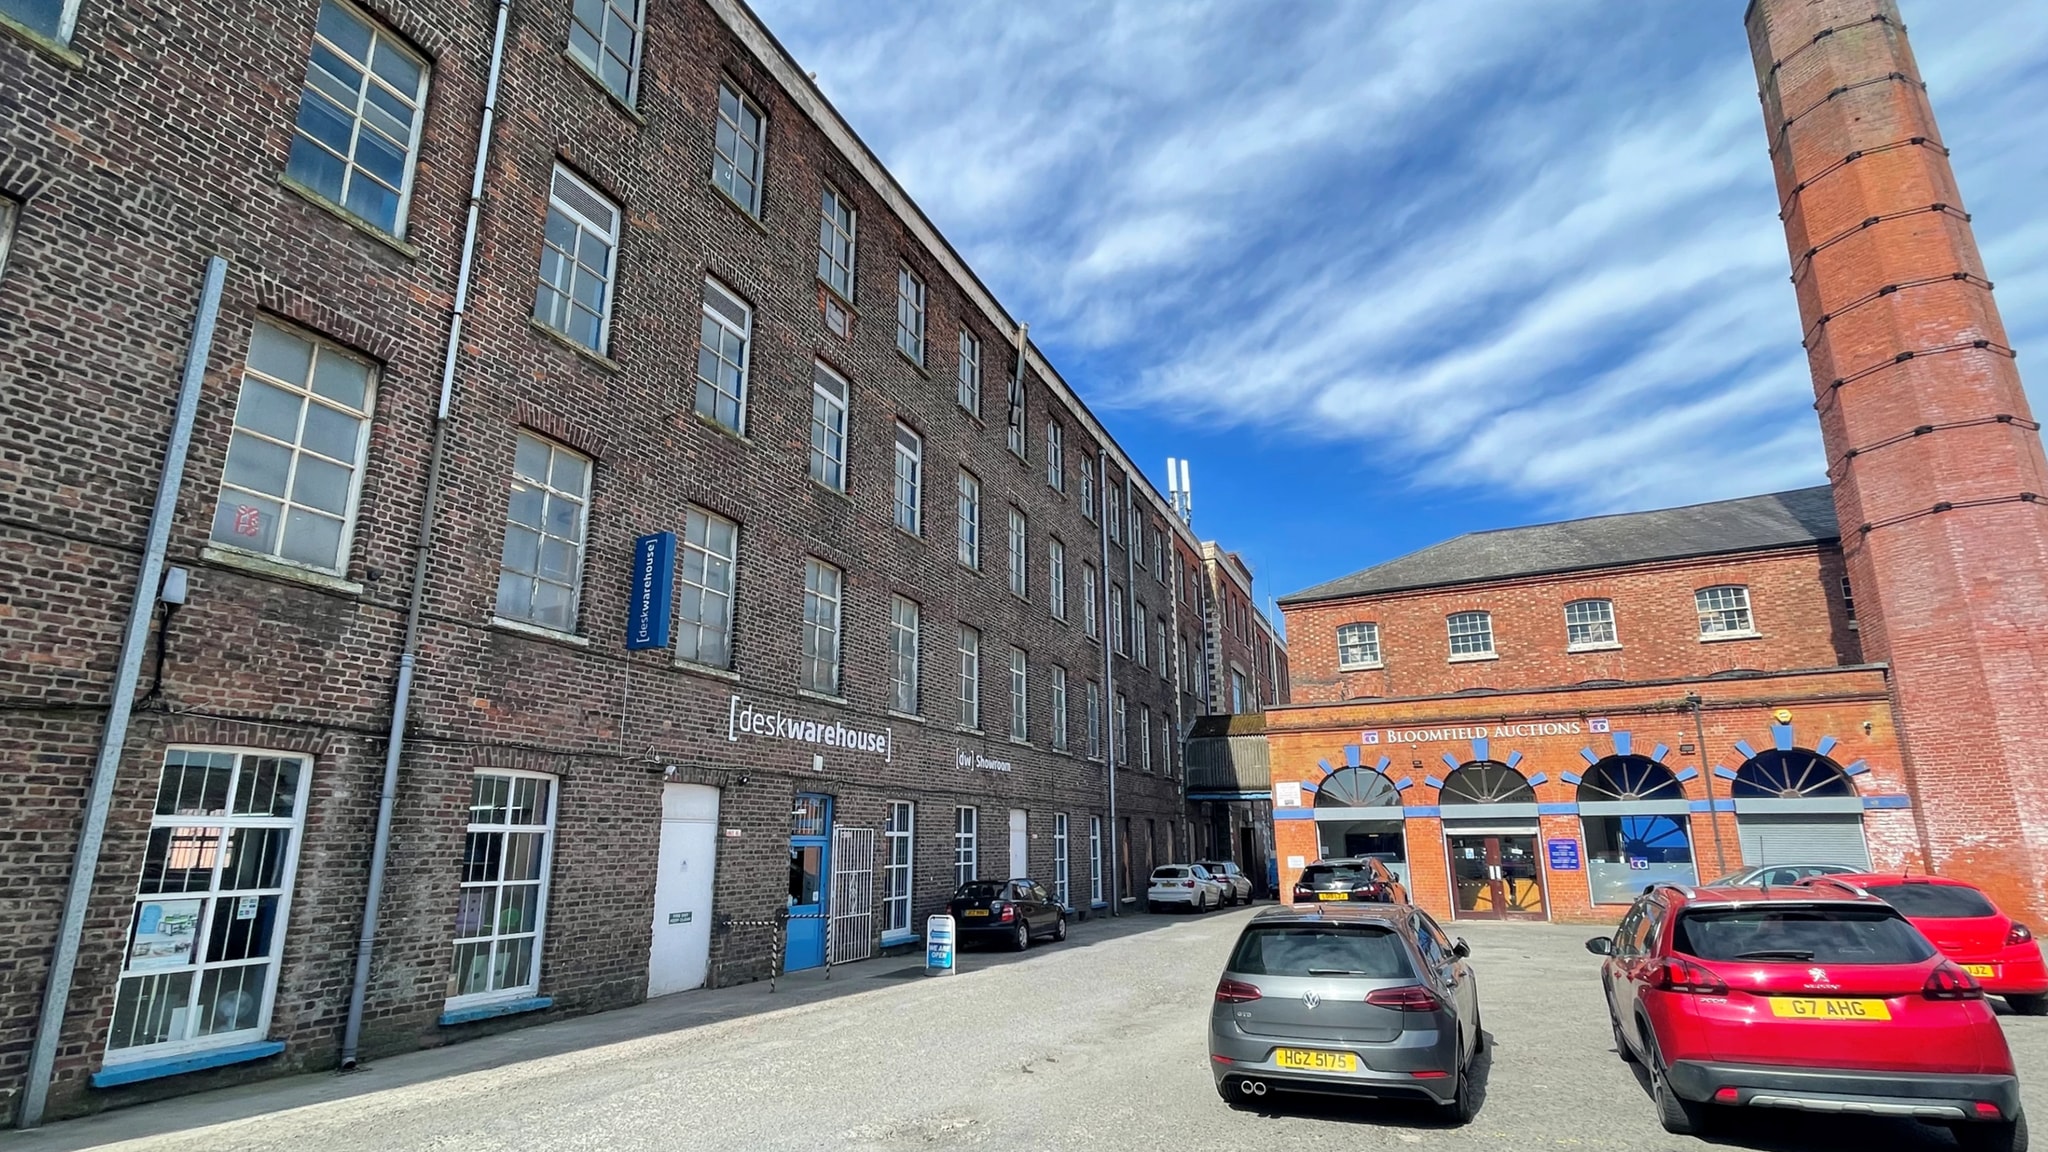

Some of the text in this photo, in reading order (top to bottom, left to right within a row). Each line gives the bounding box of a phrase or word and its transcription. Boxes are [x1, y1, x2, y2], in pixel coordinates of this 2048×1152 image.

[728, 695, 891, 762] [deskwarehouse]
[1386, 726, 1488, 744] BLOOMFIELD
[1494, 721, 1581, 739] AUCTIONS
[976, 754, 1011, 772] Showroom
[1792, 1000, 1866, 1016] G7 AHG
[1284, 1048, 1347, 1069] HGZ 5175
